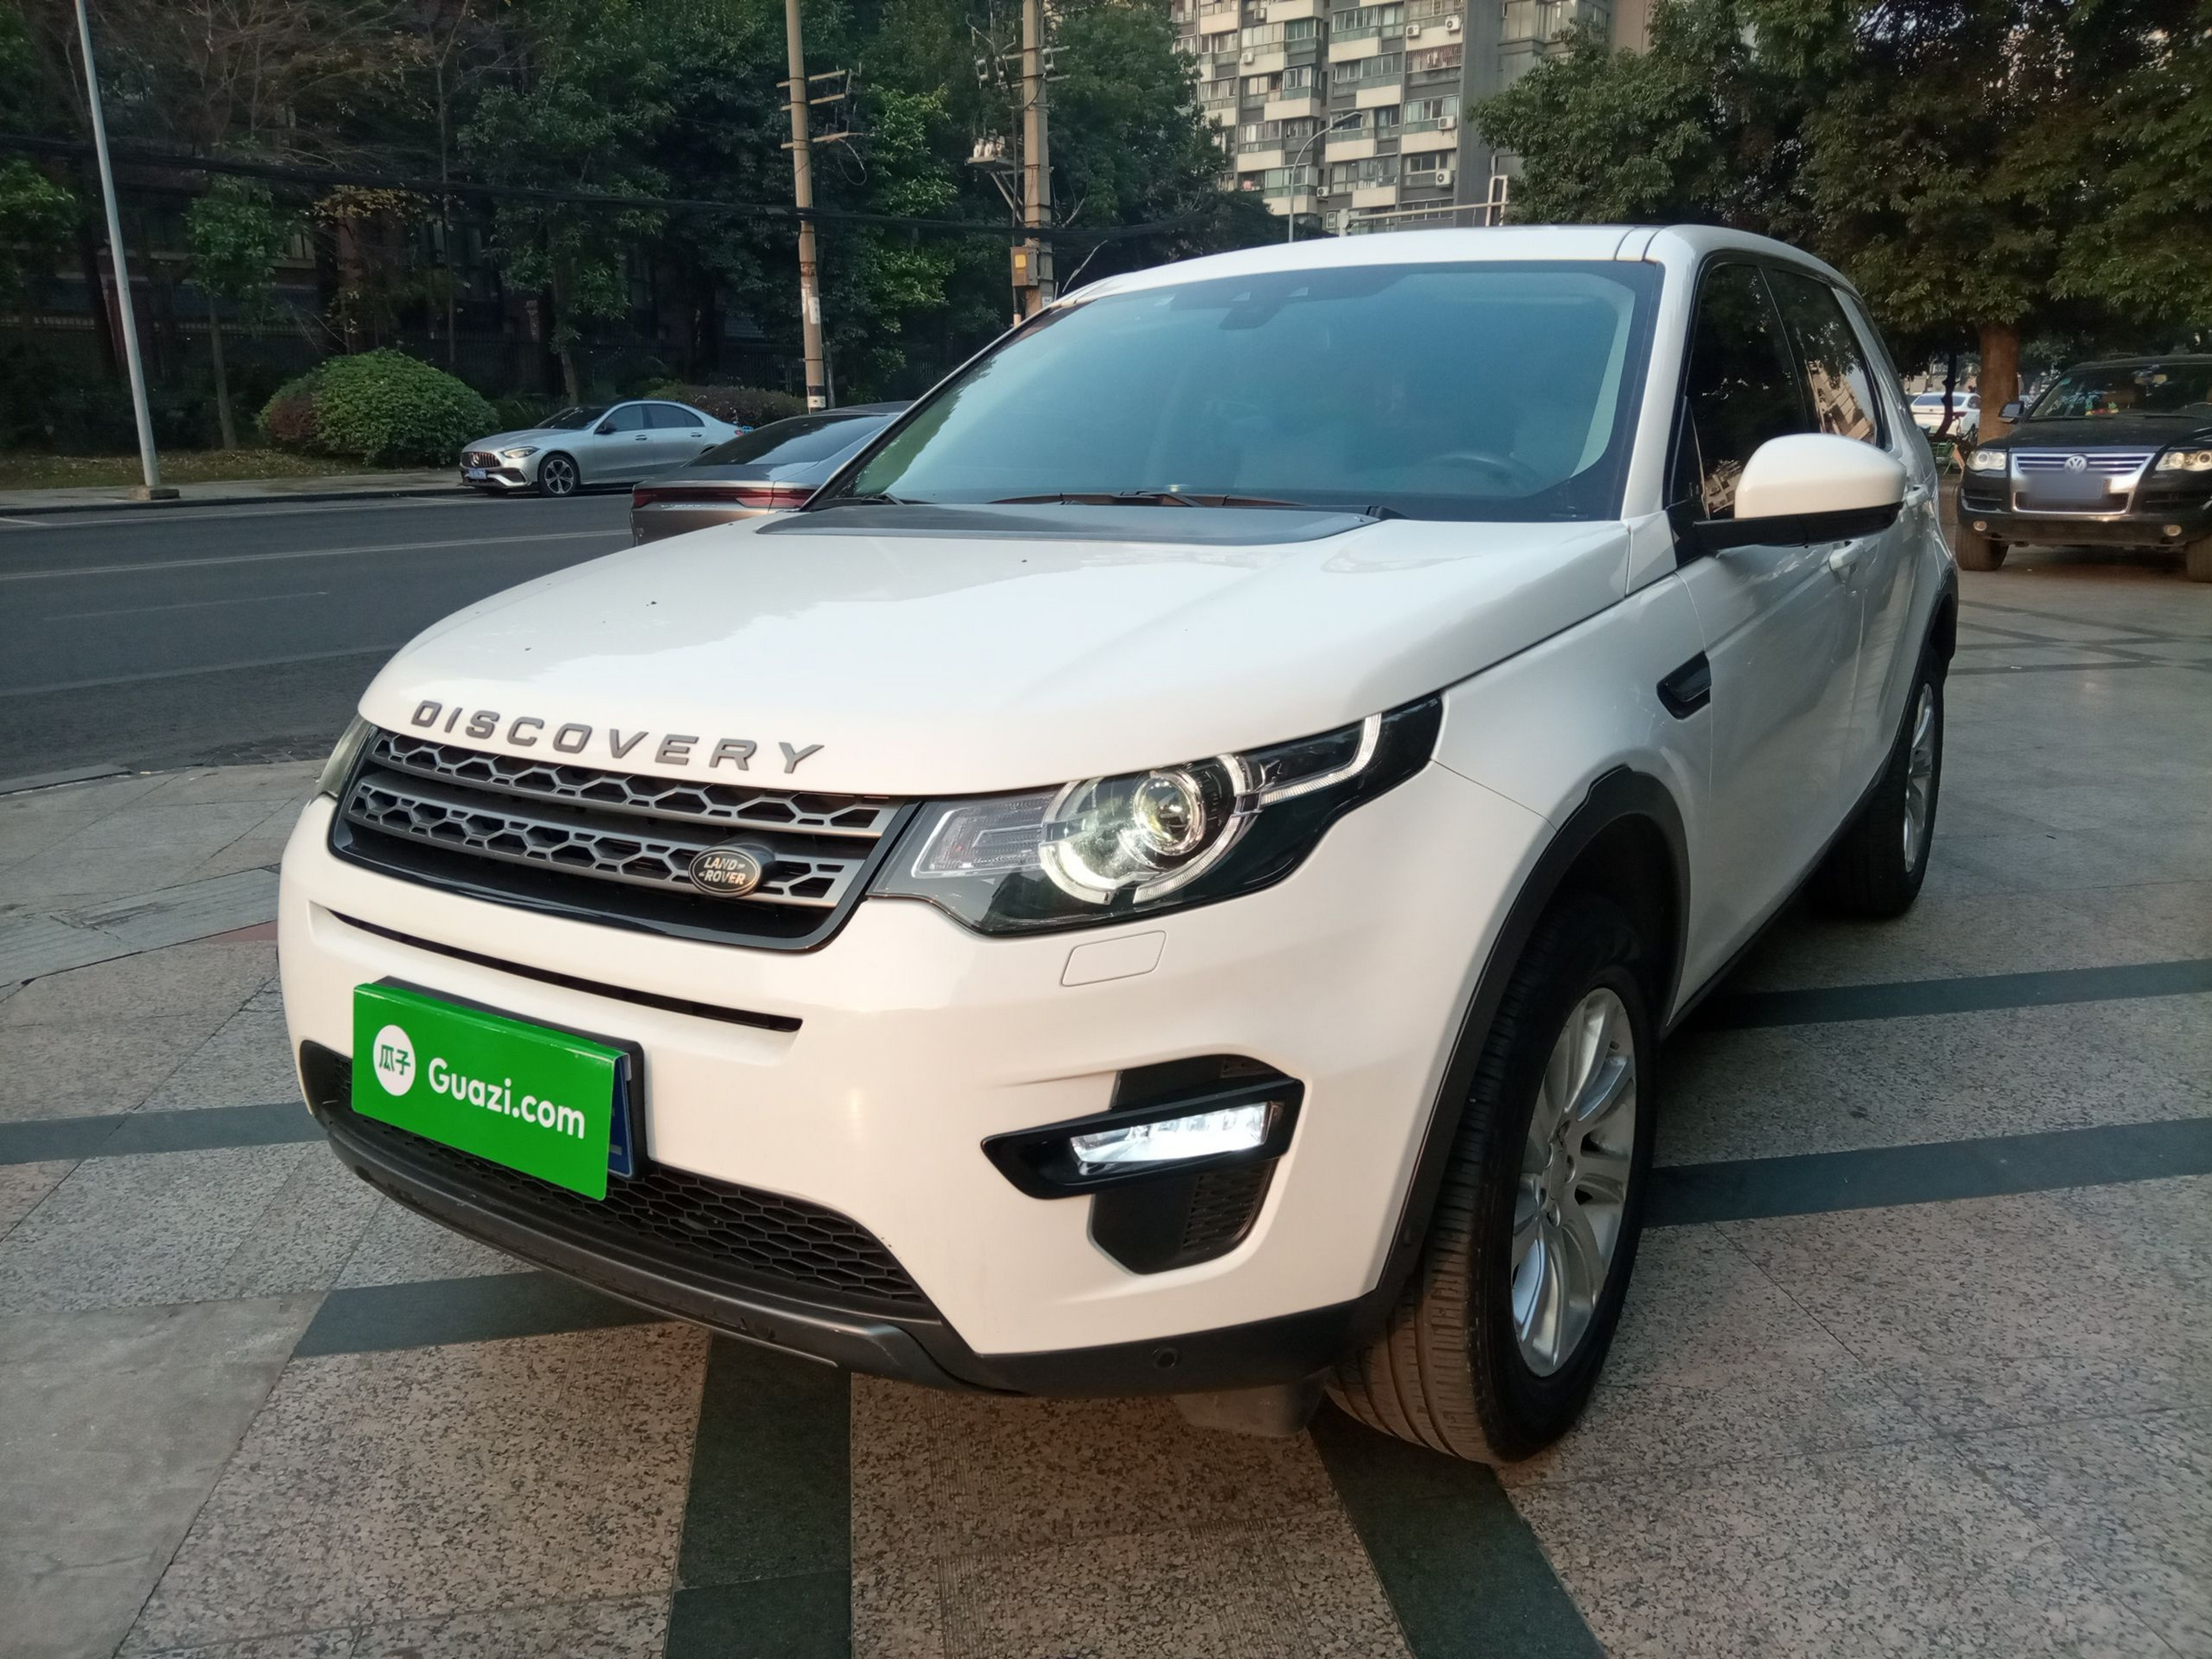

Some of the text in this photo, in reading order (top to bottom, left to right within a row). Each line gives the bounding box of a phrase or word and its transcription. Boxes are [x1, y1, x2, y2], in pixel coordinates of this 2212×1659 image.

[410, 700, 825, 774] DISCOVERY
[378, 1043, 411, 1076] 瓜子
[428, 1057, 586, 1140] Guazi.com
